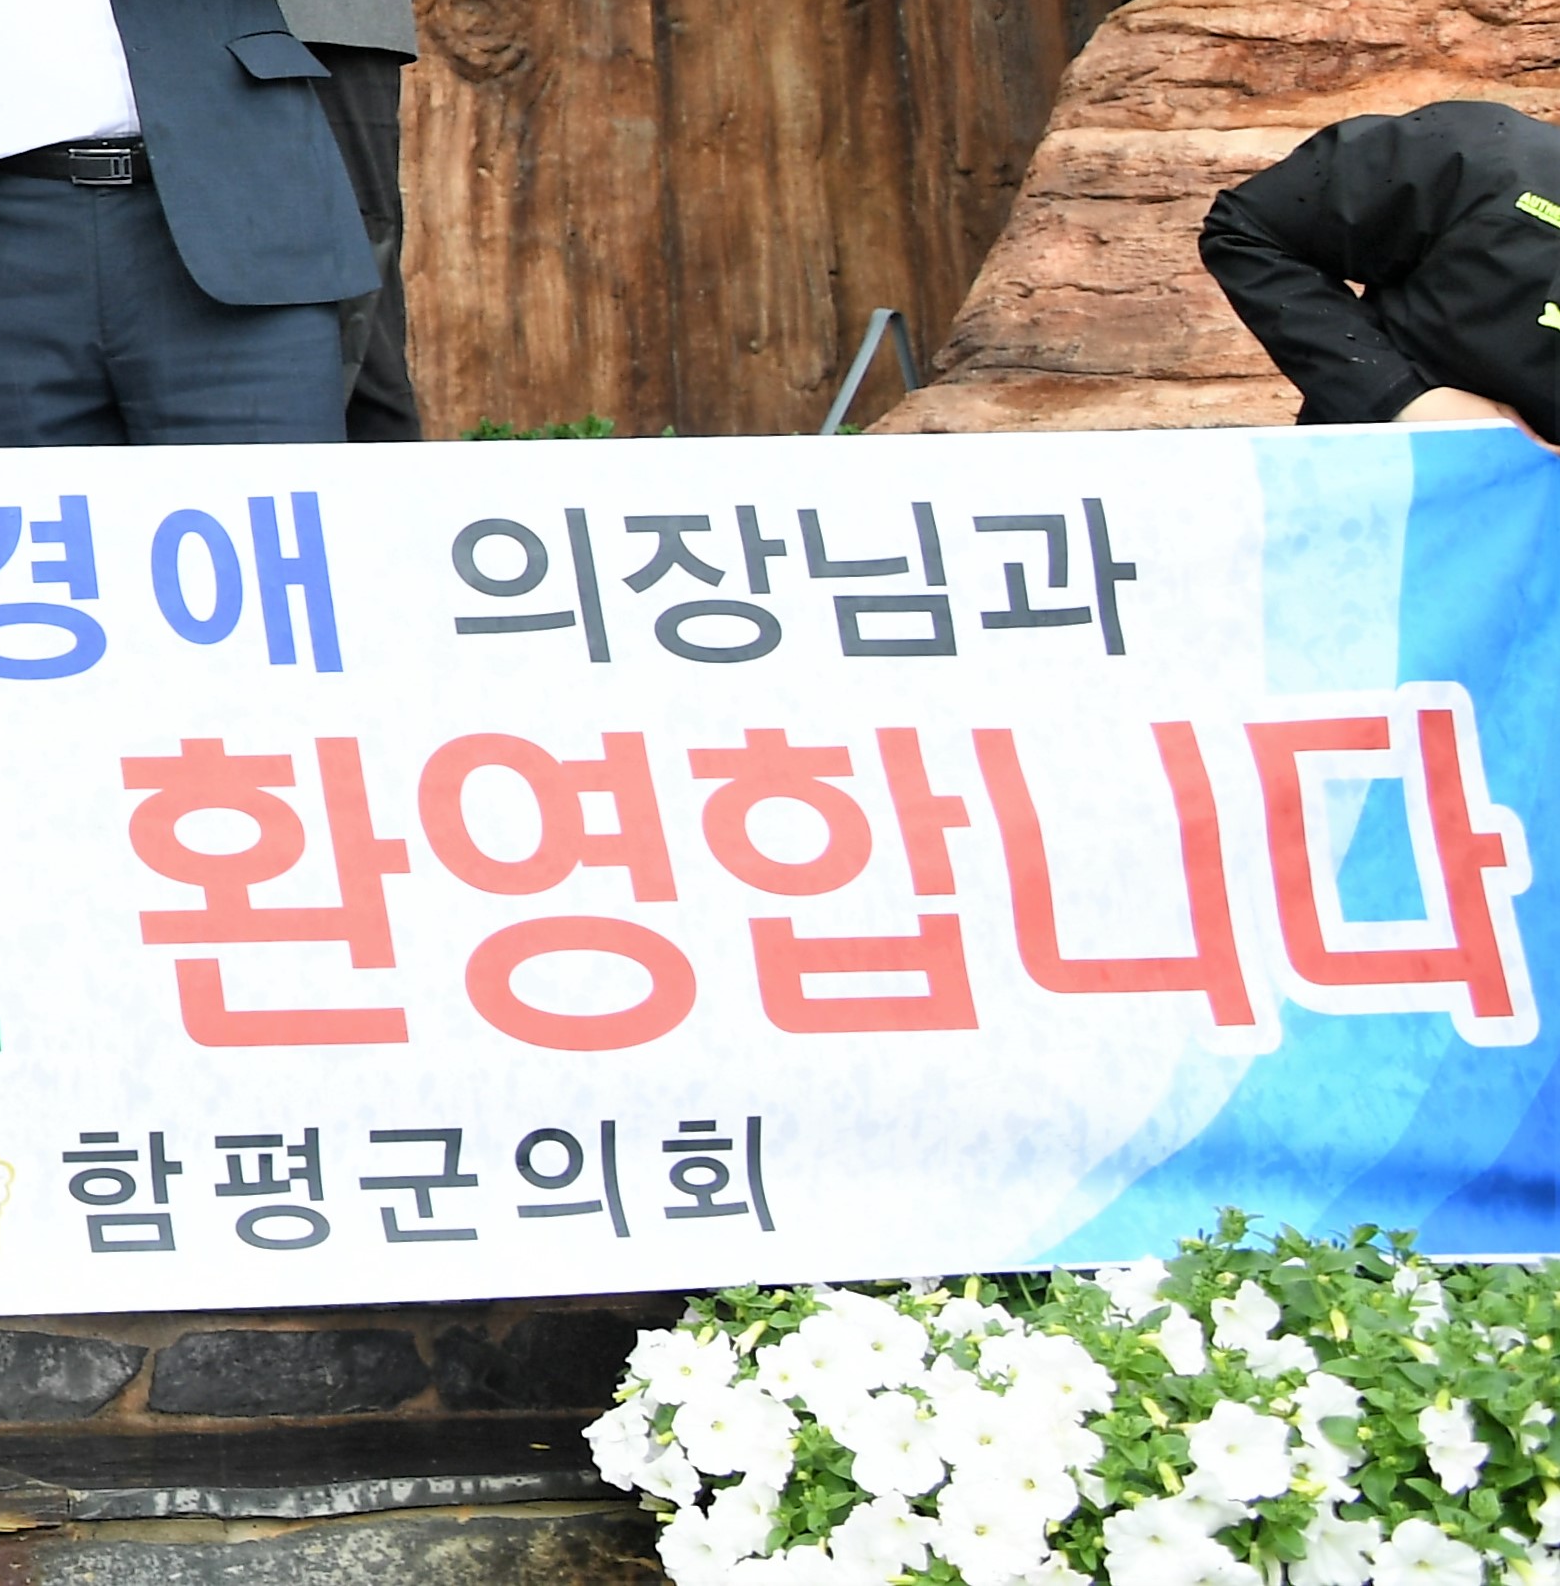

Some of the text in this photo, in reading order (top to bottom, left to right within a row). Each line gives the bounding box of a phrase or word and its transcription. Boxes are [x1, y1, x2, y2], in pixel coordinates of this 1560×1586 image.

[452, 498, 1139, 665] 의장님과
[120, 710, 1515, 1053] 환영합니다
[62, 1116, 777, 1255] 함평군의회
